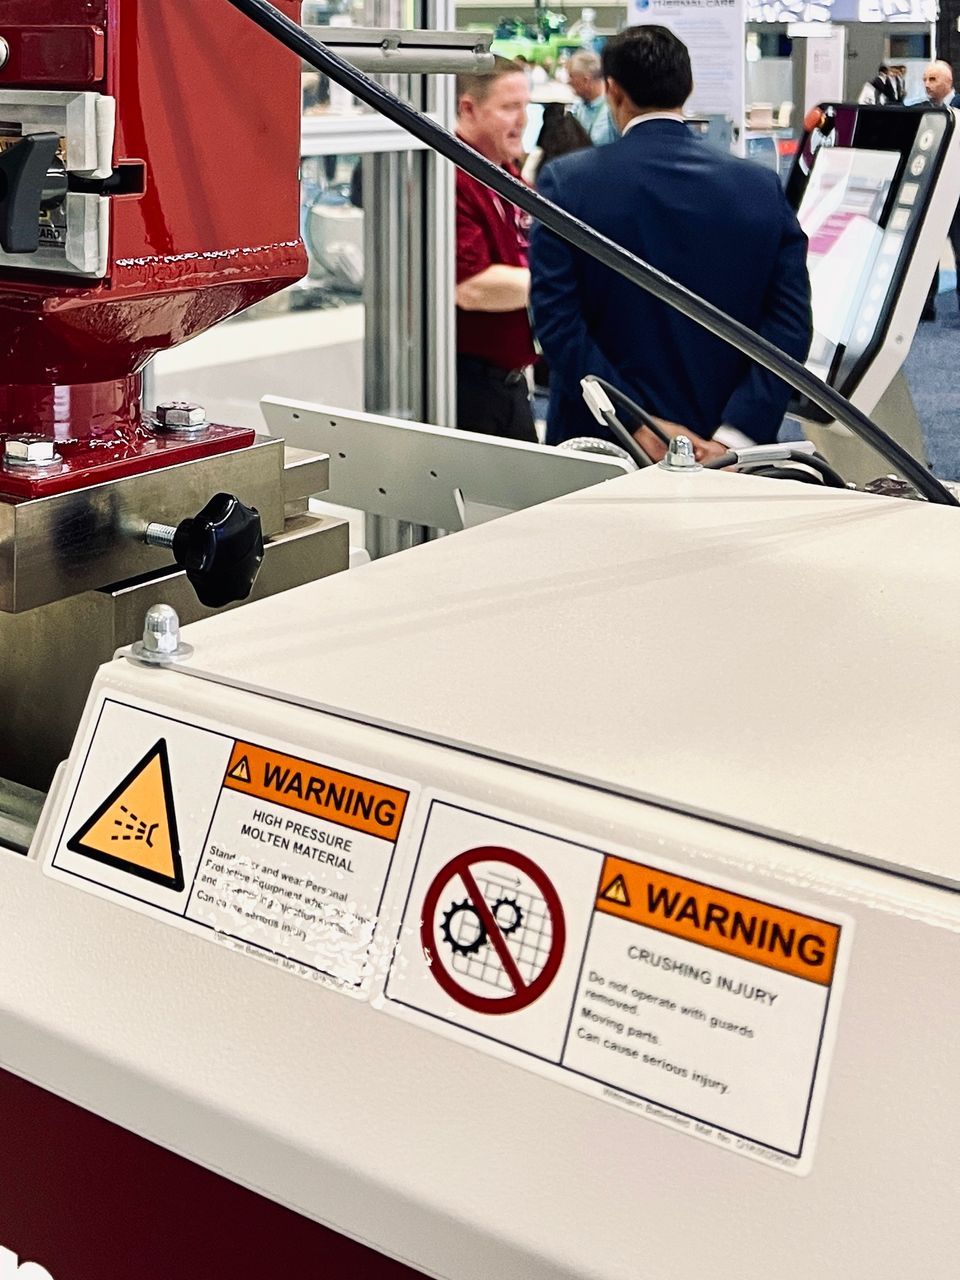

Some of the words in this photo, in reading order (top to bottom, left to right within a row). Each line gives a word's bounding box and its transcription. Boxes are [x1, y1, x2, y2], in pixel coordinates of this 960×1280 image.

[263, 762, 398, 827] WARNING
[240, 824, 290, 850] MOLTEN
[293, 841, 355, 873] MATERIAL
[252, 809, 283, 829] HIGH
[285, 820, 353, 853] PRESSURE
[196, 889, 214, 903] Can
[261, 865, 280, 878] and
[281, 873, 304, 886] wear
[646, 883, 826, 967] WARNING
[626, 945, 712, 986] CRUSHING
[716, 974, 779, 1007] INJURY
[581, 1006, 624, 1034] Moving
[626, 1025, 663, 1046] parts.
[585, 989, 640, 1016] removed.
[588, 971, 605, 985] Do
[608, 980, 628, 993] not
[631, 987, 677, 1011] operate
[680, 1005, 707, 1021] with
[709, 1015, 754, 1039] guards
[577, 1026, 600, 1045] Can
[603, 1038, 640, 1060] cause
[642, 1053, 688, 1078] serious
[691, 1070, 730, 1095] injury.
